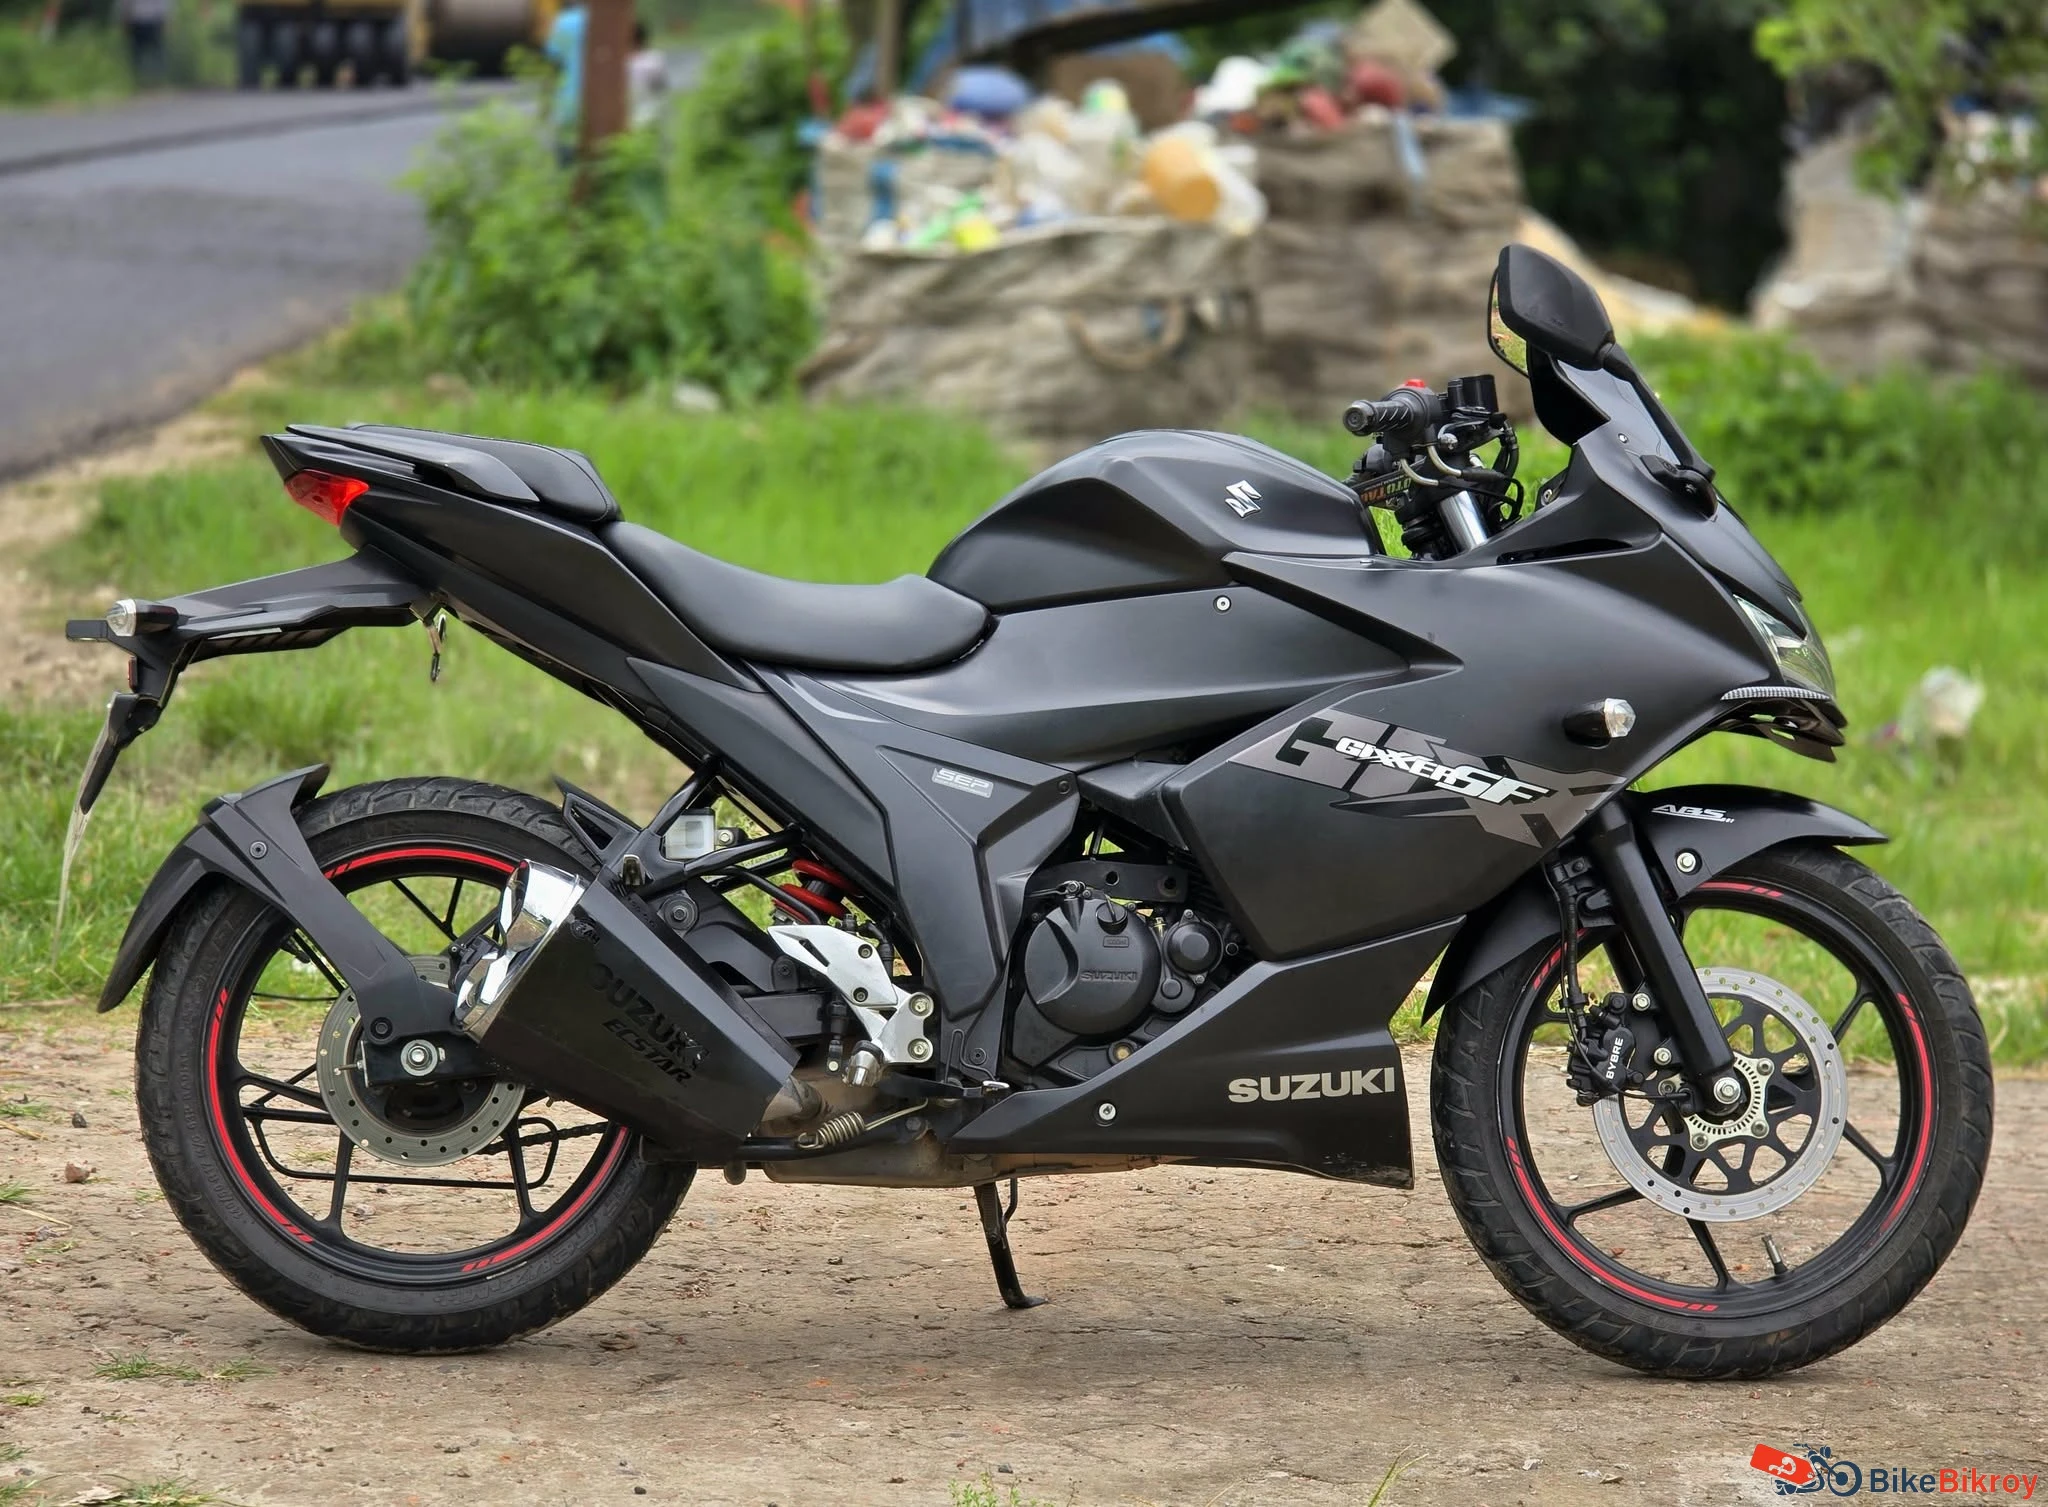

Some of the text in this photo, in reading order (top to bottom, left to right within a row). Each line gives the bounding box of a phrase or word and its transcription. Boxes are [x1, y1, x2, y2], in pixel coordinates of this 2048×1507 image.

[934, 767, 990, 788] SEP
[1651, 804, 1727, 819] ABS
[1079, 970, 1138, 983] SUZUKI
[602, 1017, 693, 1084] ECSTAR
[1605, 1037, 1624, 1080] BYBRE
[1227, 1066, 1396, 1104] SUZUKI
